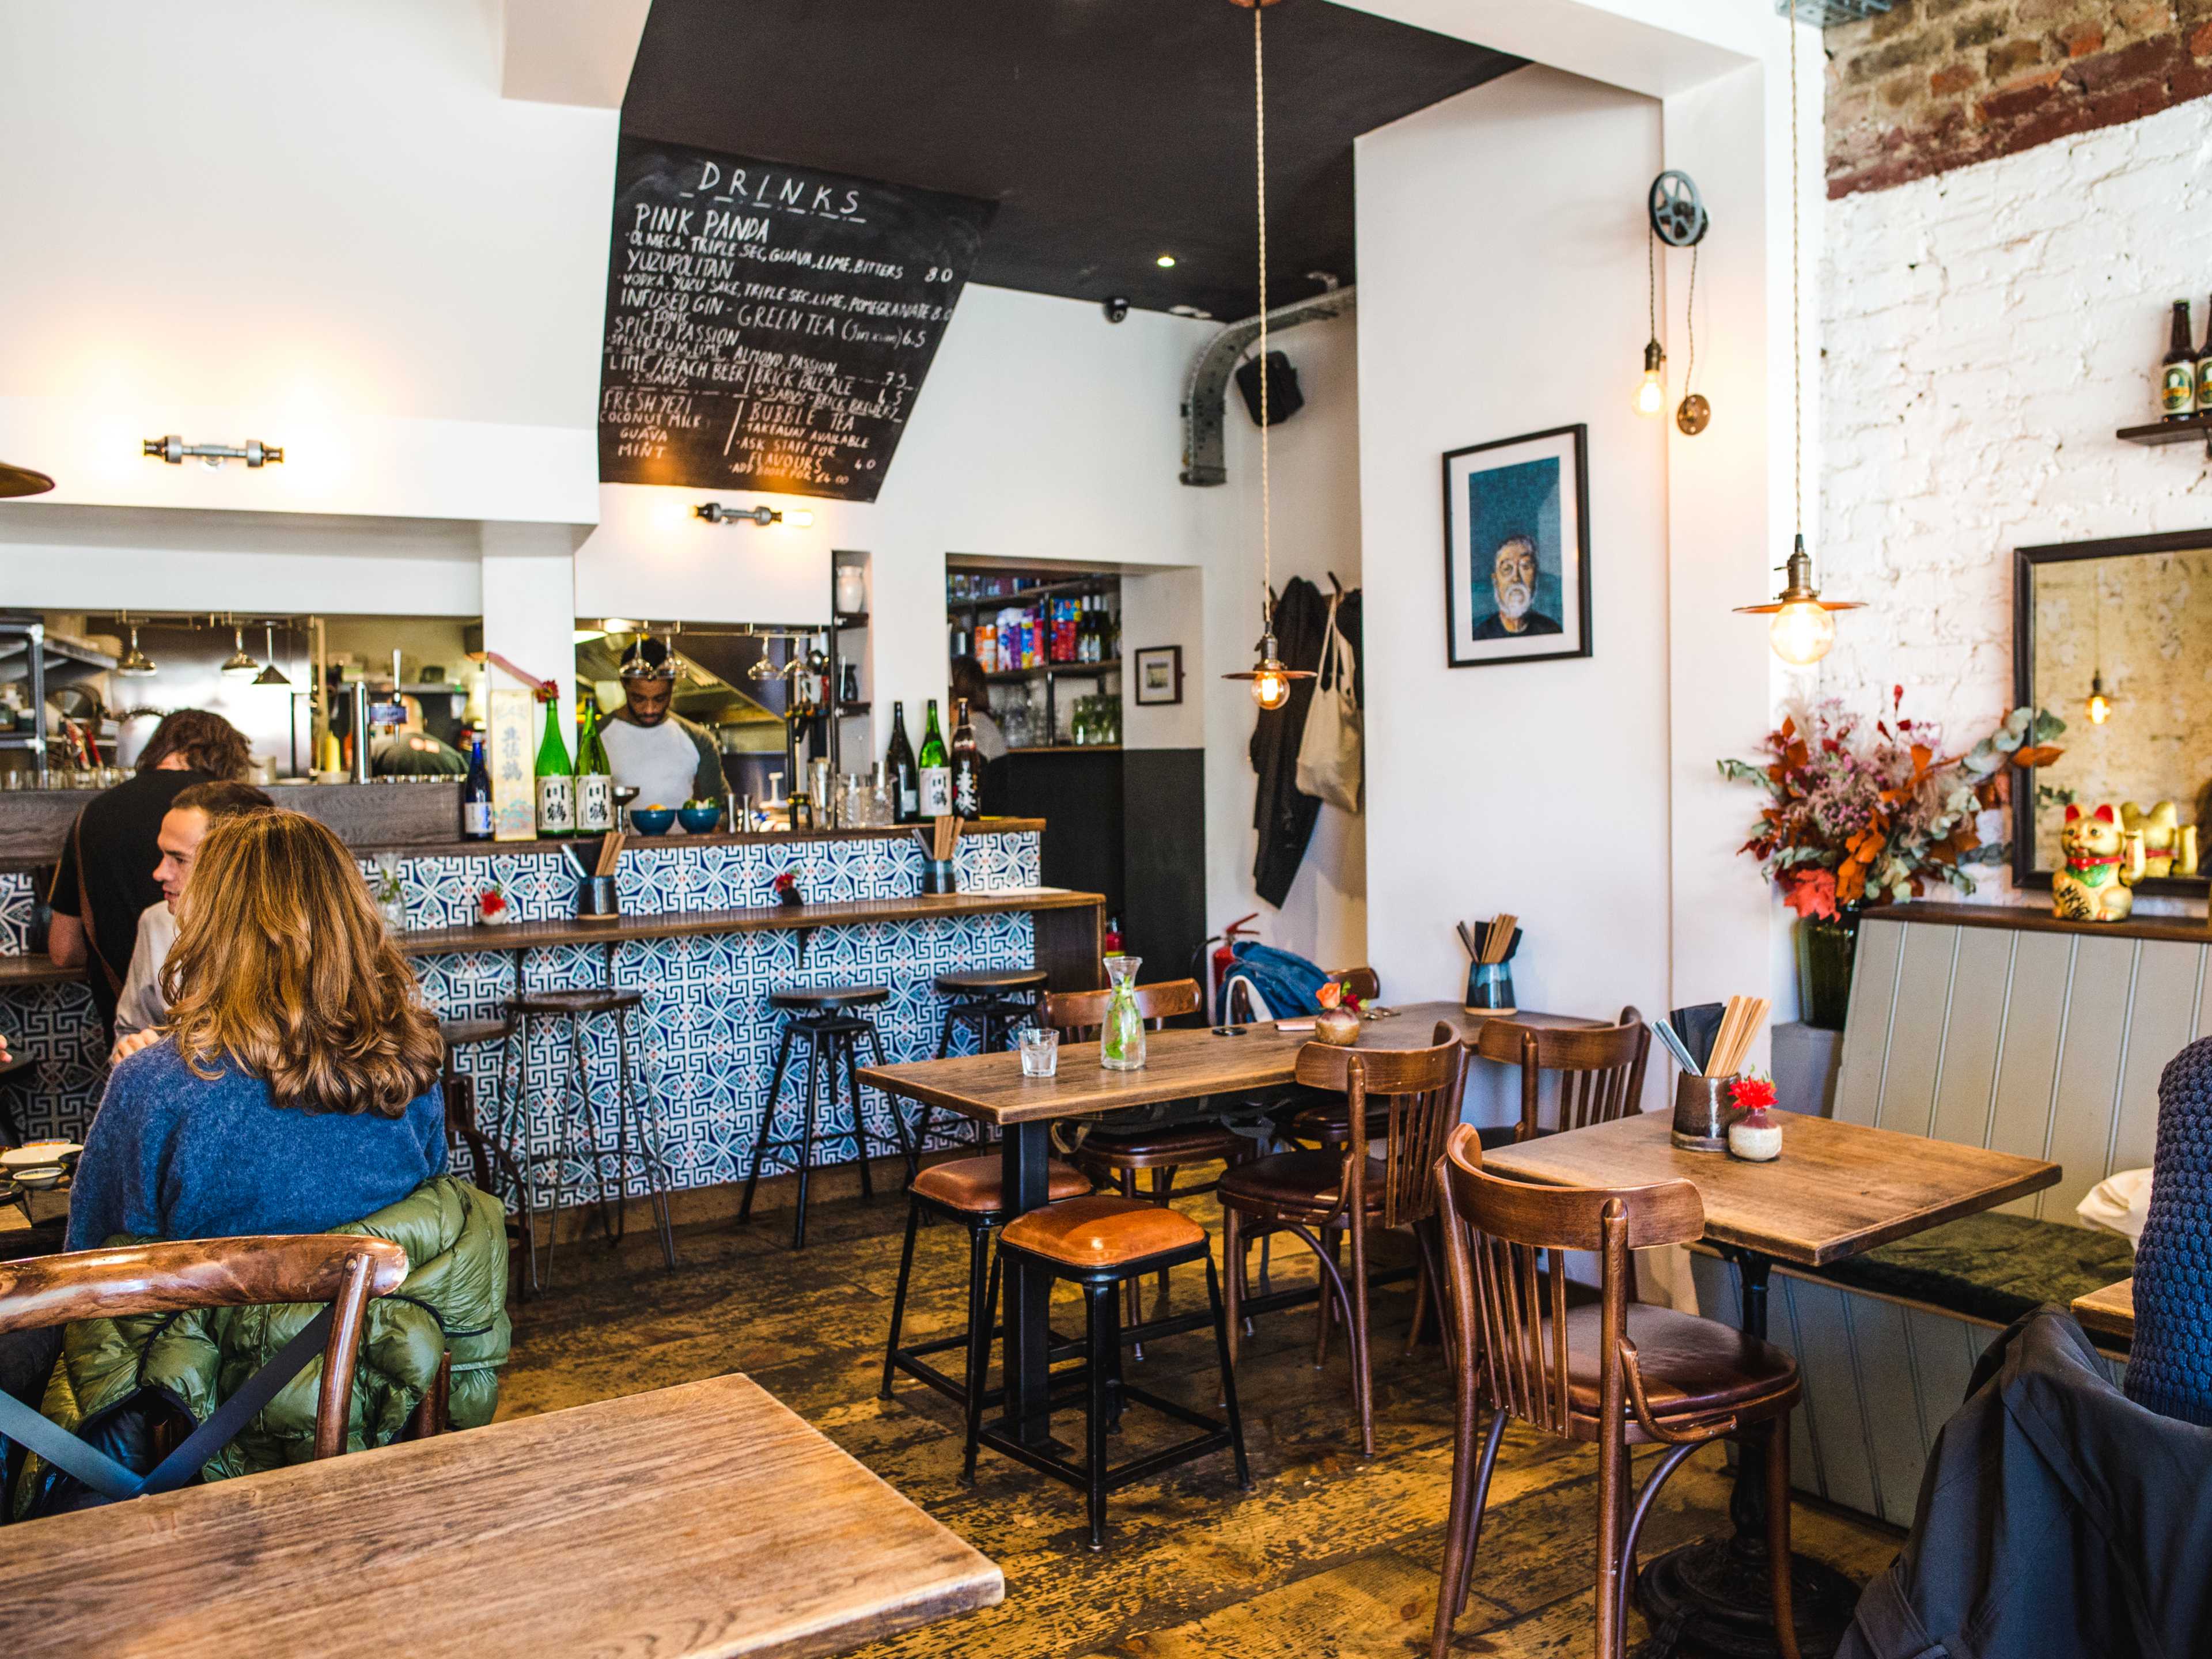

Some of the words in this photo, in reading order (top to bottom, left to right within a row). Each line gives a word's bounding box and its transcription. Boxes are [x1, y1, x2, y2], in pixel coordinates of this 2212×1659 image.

[698, 161, 859, 214] DRINKS
[635, 203, 694, 236] PINK
[703, 210, 770, 243] PANDA
[627, 249, 734, 279] YUZUPOLITAN
[691, 236, 737, 257] TRIPLE
[854, 259, 904, 280] BITTERS
[672, 275, 706, 291] YUZU
[744, 282, 787, 301] TRIPLE
[848, 296, 931, 320] POMEGRANATE
[620, 287, 690, 312] INFUSED
[692, 294, 724, 316] GIN
[737, 304, 804, 331] GREEN
[806, 313, 835, 336] TEA
[653, 308, 690, 324] TONIC
[614, 316, 671, 338] SPICED
[675, 322, 740, 346] PASSION
[712, 363, 745, 382] BEER
[789, 353, 838, 377] PASSION
[754, 362, 796, 387] BRICK
[798, 372, 824, 393] PALE
[826, 377, 853, 396] ALE
[603, 389, 658, 413] FRESH
[599, 410, 661, 426] COCONUT
[667, 414, 702, 428] MILK
[748, 401, 817, 426] BUBBLE
[830, 412, 855, 431] TEA
[619, 427, 668, 442] GUAVA
[740, 436, 765, 451] ASK
[773, 439, 809, 455] STAFF
[810, 444, 837, 458] FOR
[747, 422, 806, 438] TAKEAWAY
[810, 430, 870, 449] AVAILABLE
[618, 443, 666, 459] MINT
[749, 451, 824, 474] FLAVOURS
[732, 462, 753, 474] ADD
[789, 469, 812, 480] FOR
